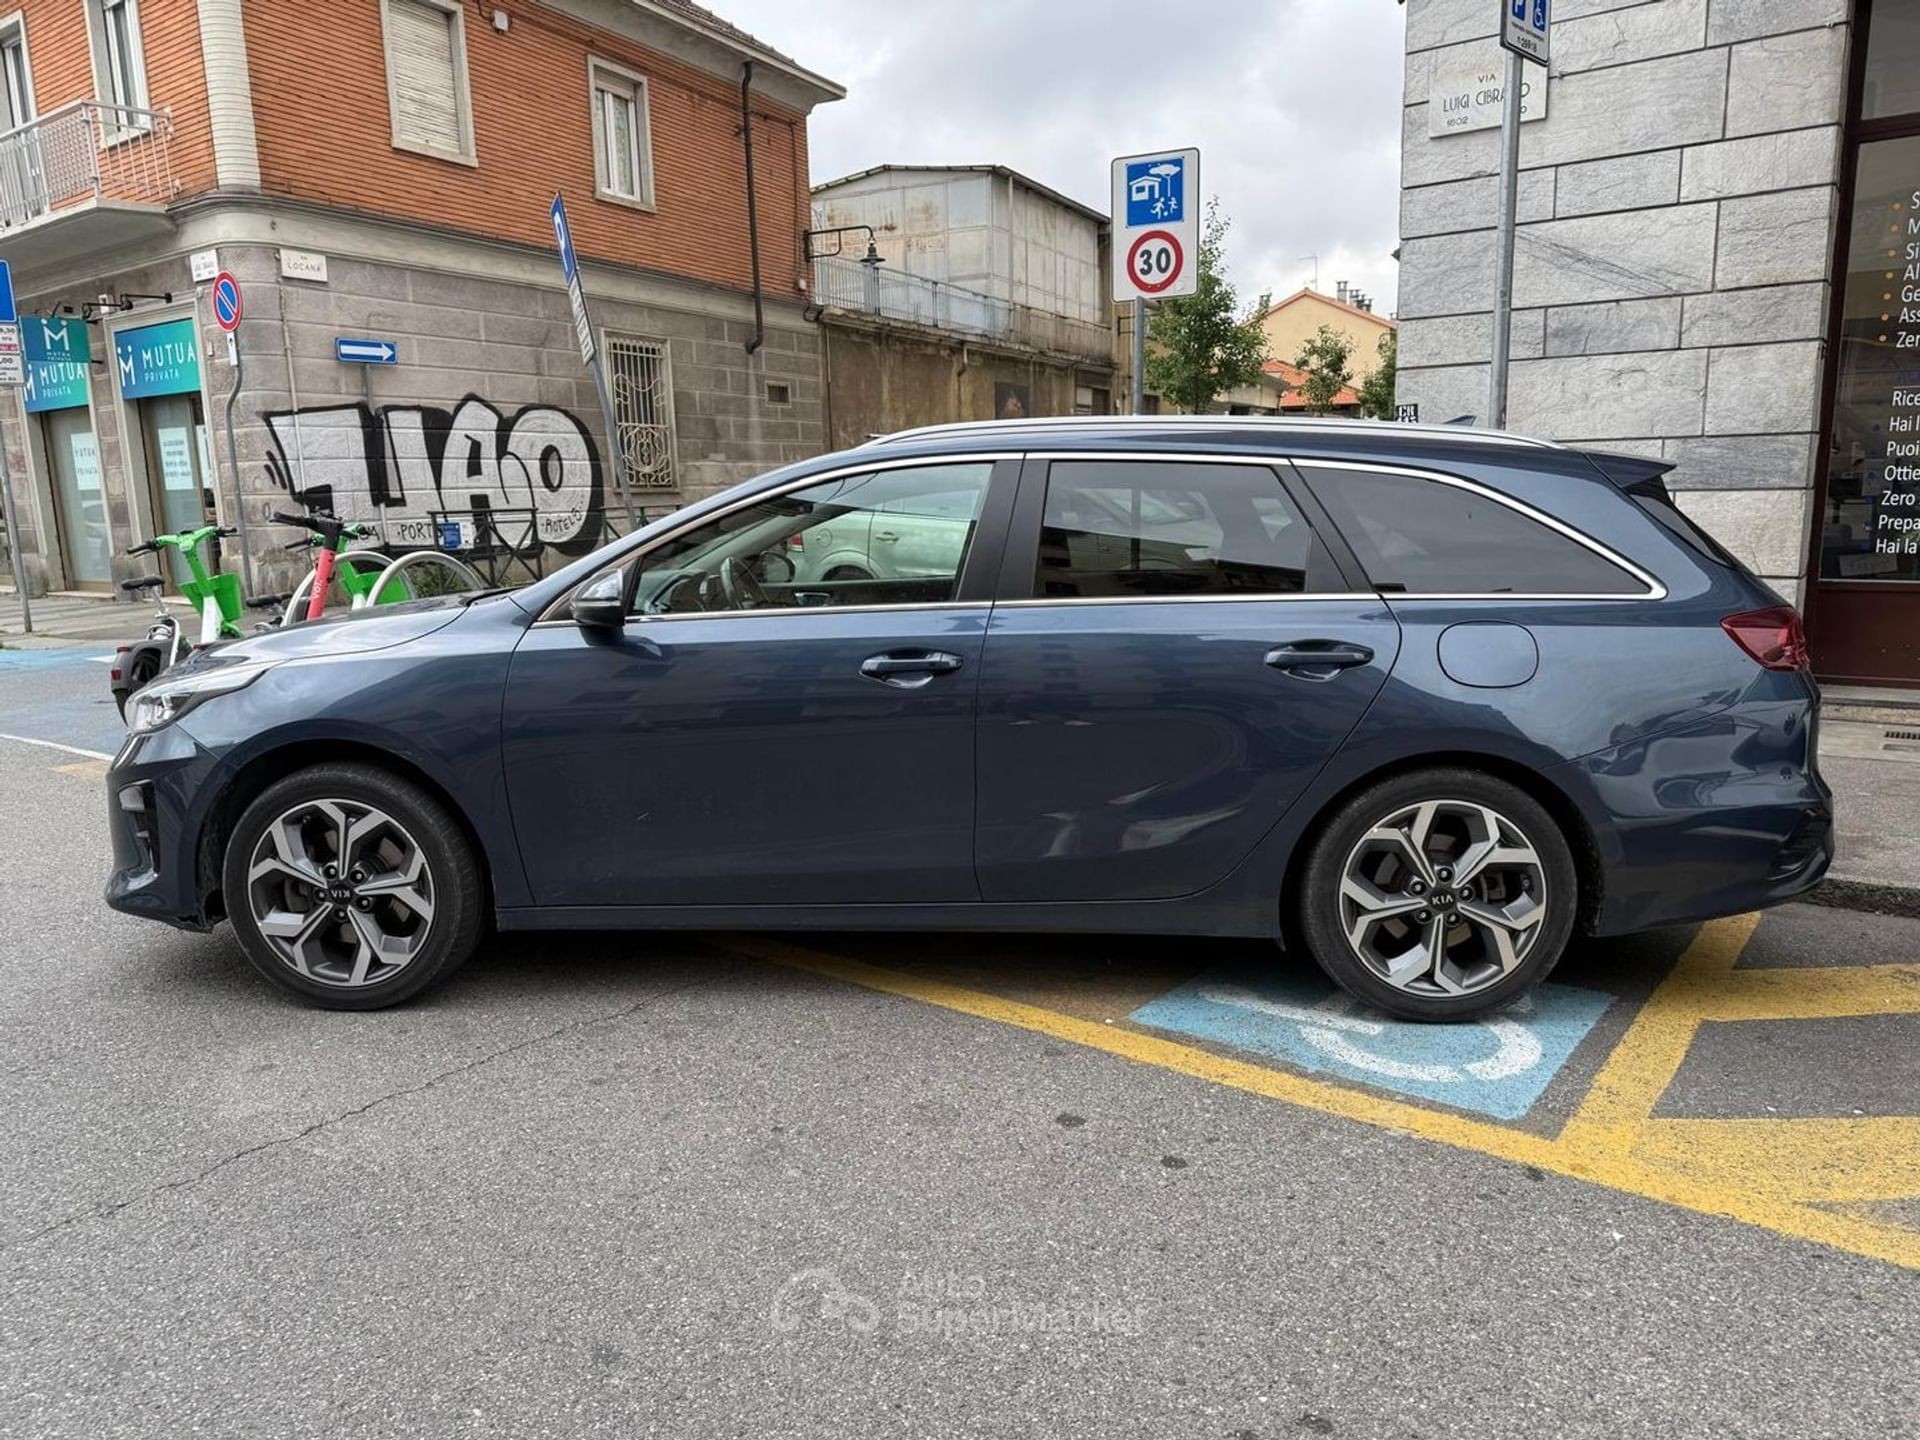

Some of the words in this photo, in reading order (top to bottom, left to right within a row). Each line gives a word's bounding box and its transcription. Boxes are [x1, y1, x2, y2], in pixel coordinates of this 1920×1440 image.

[1478, 73, 1496, 83] VIA
[1443, 93, 1470, 112] LUIGI
[287, 261, 321, 273] LOCANA
[1139, 247, 1171, 276] 30
[1901, 285, 1920, 303] Ge
[1896, 331, 1920, 348] Zer
[141, 341, 196, 369] MUTUA
[39, 362, 85, 386] MUTUA
[144, 369, 179, 383] PRIVATA
[42, 385, 72, 399] PRIVATA
[1892, 390, 1920, 407] Rice
[1889, 415, 1912, 432] Hai
[1886, 440, 1920, 457] Puoi
[1884, 464, 1920, 481] Ottie
[1881, 490, 1916, 506] Zero
[1878, 514, 1920, 533] Prepa
[1876, 538, 1900, 553] Hai
[1904, 538, 1917, 554] la
[1432, 894, 1454, 905] KIA
